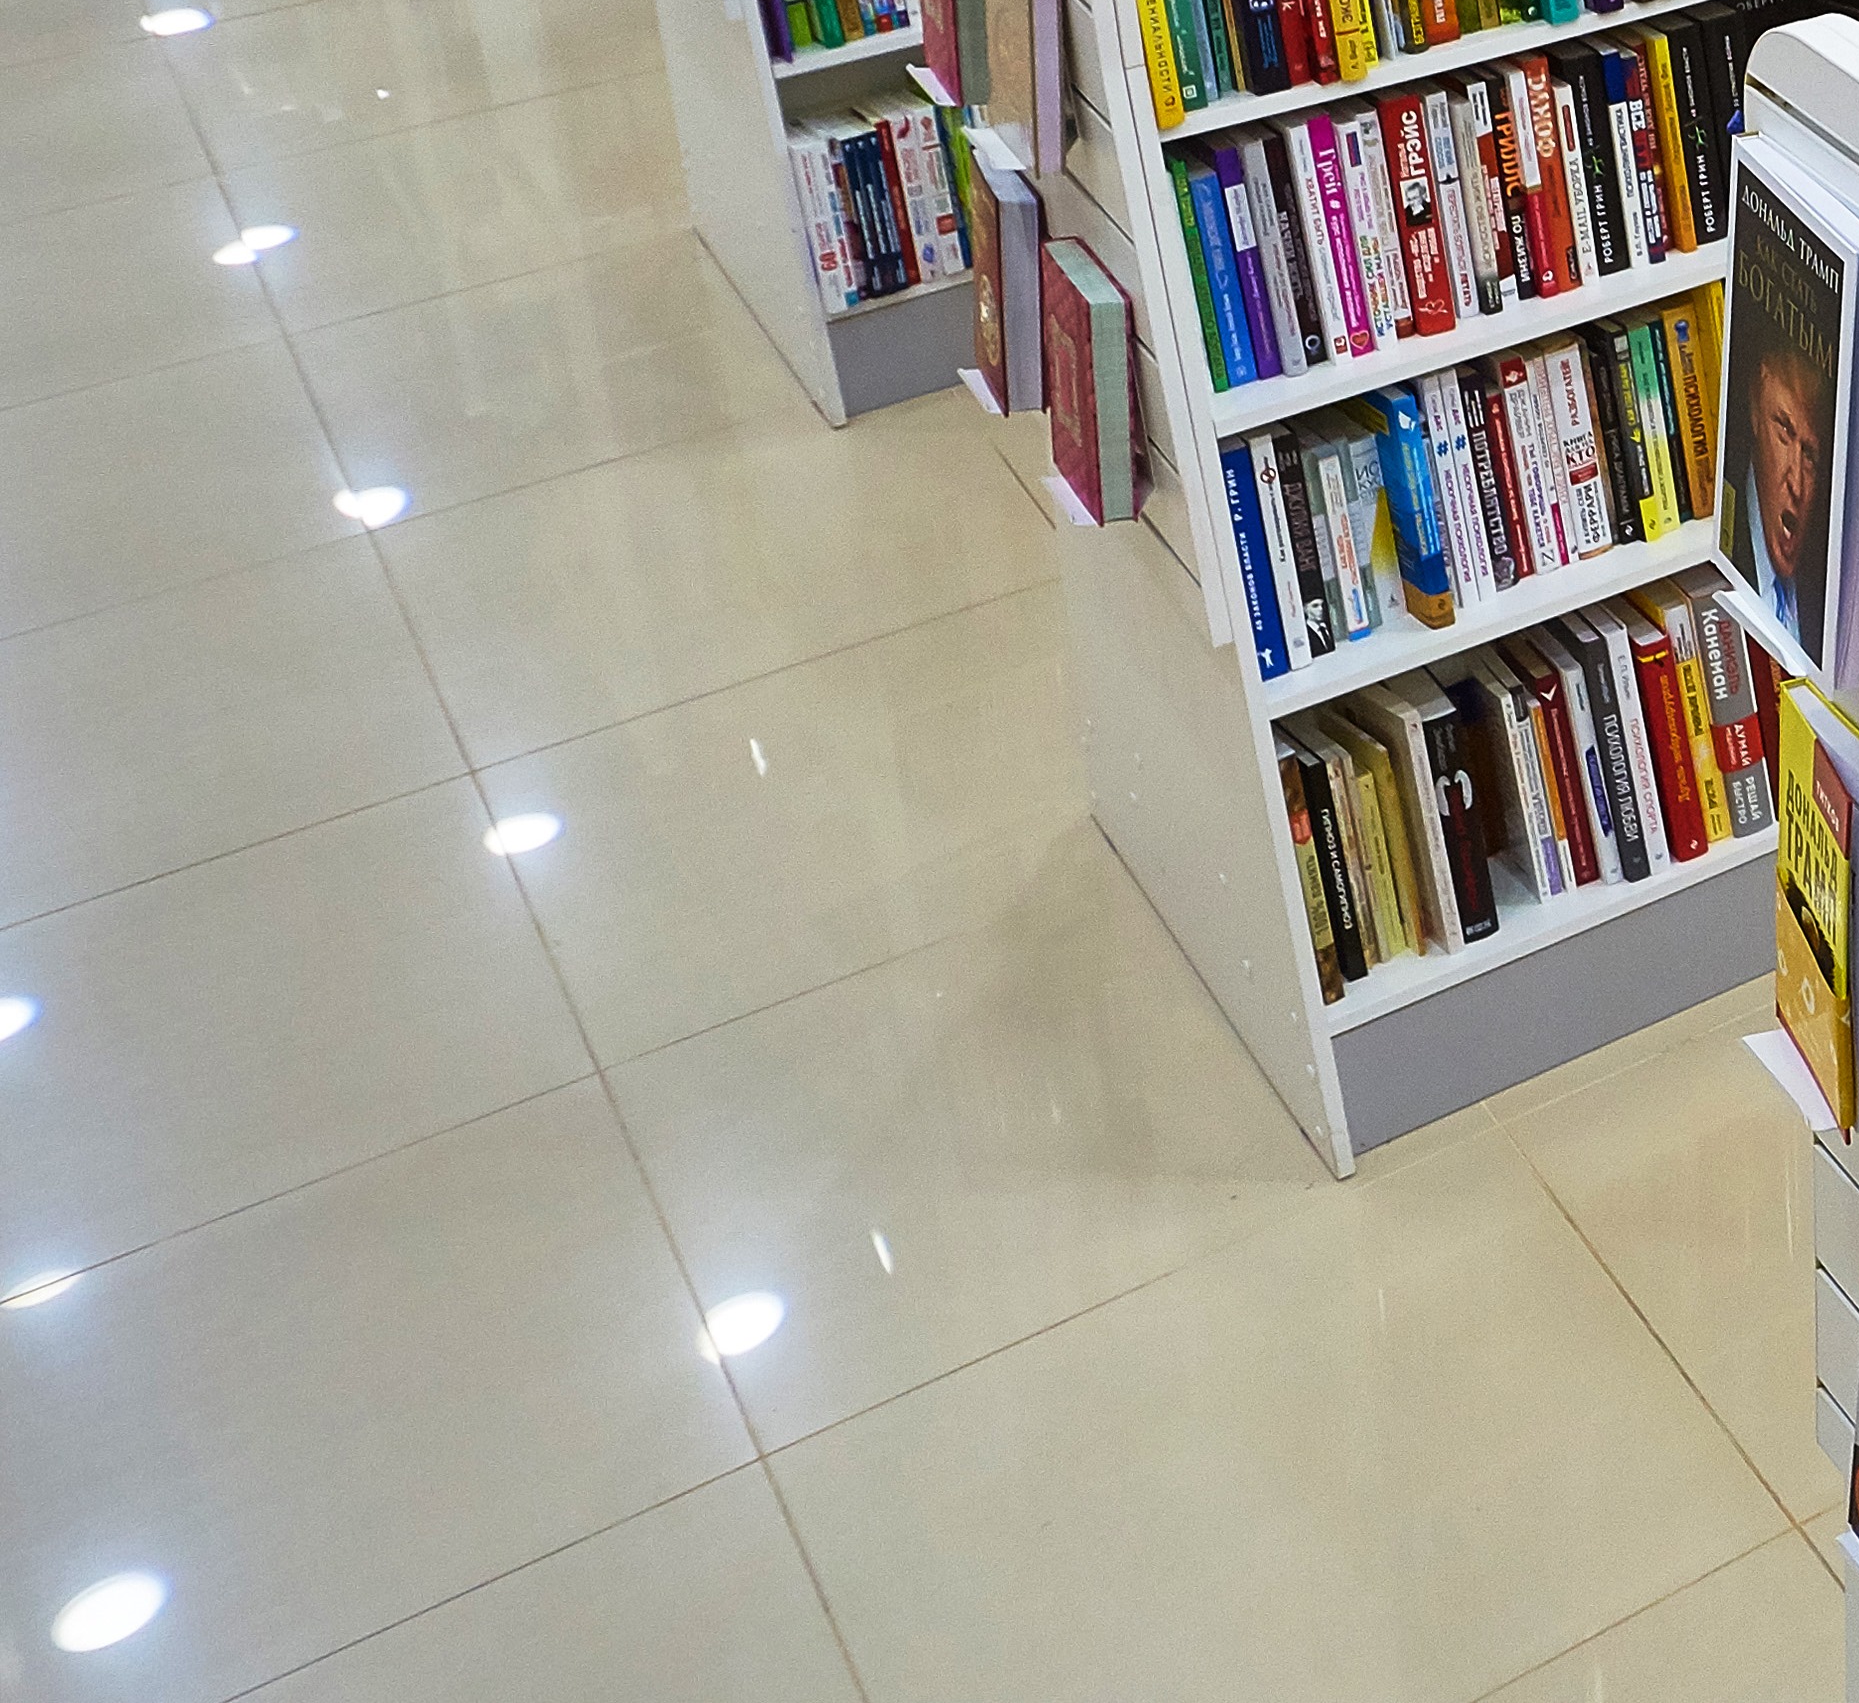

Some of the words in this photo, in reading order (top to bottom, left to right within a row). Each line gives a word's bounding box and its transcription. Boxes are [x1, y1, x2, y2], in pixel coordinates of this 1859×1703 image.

[1530, 72, 1556, 157] ФОКУС
[1401, 110, 1426, 177] ГРЭЙС
[1697, 154, 1707, 185] ГРИН
[1595, 184, 1605, 214] ГРИН
[1704, 189, 1716, 233] РОБЕРТ
[1603, 215, 1614, 264] РОБЕРТ
[1742, 183, 1795, 252] ДОНАЛЬД
[1799, 233, 1839, 295] ТРАМП
[1738, 250, 1835, 379] БОГАТЫМ
[1565, 445, 1596, 469] КТО
[1472, 430, 1507, 554] ПОТРЕБЛЯТСТВО
[1702, 608, 1728, 700] Канеман
[1734, 724, 1752, 768] ДУМАЙ
[1733, 780, 1747, 825] БЫСТРО
[1745, 777, 1762, 820] РЕШАЙ
[1786, 764, 1840, 875] ДОНАЛЬД
